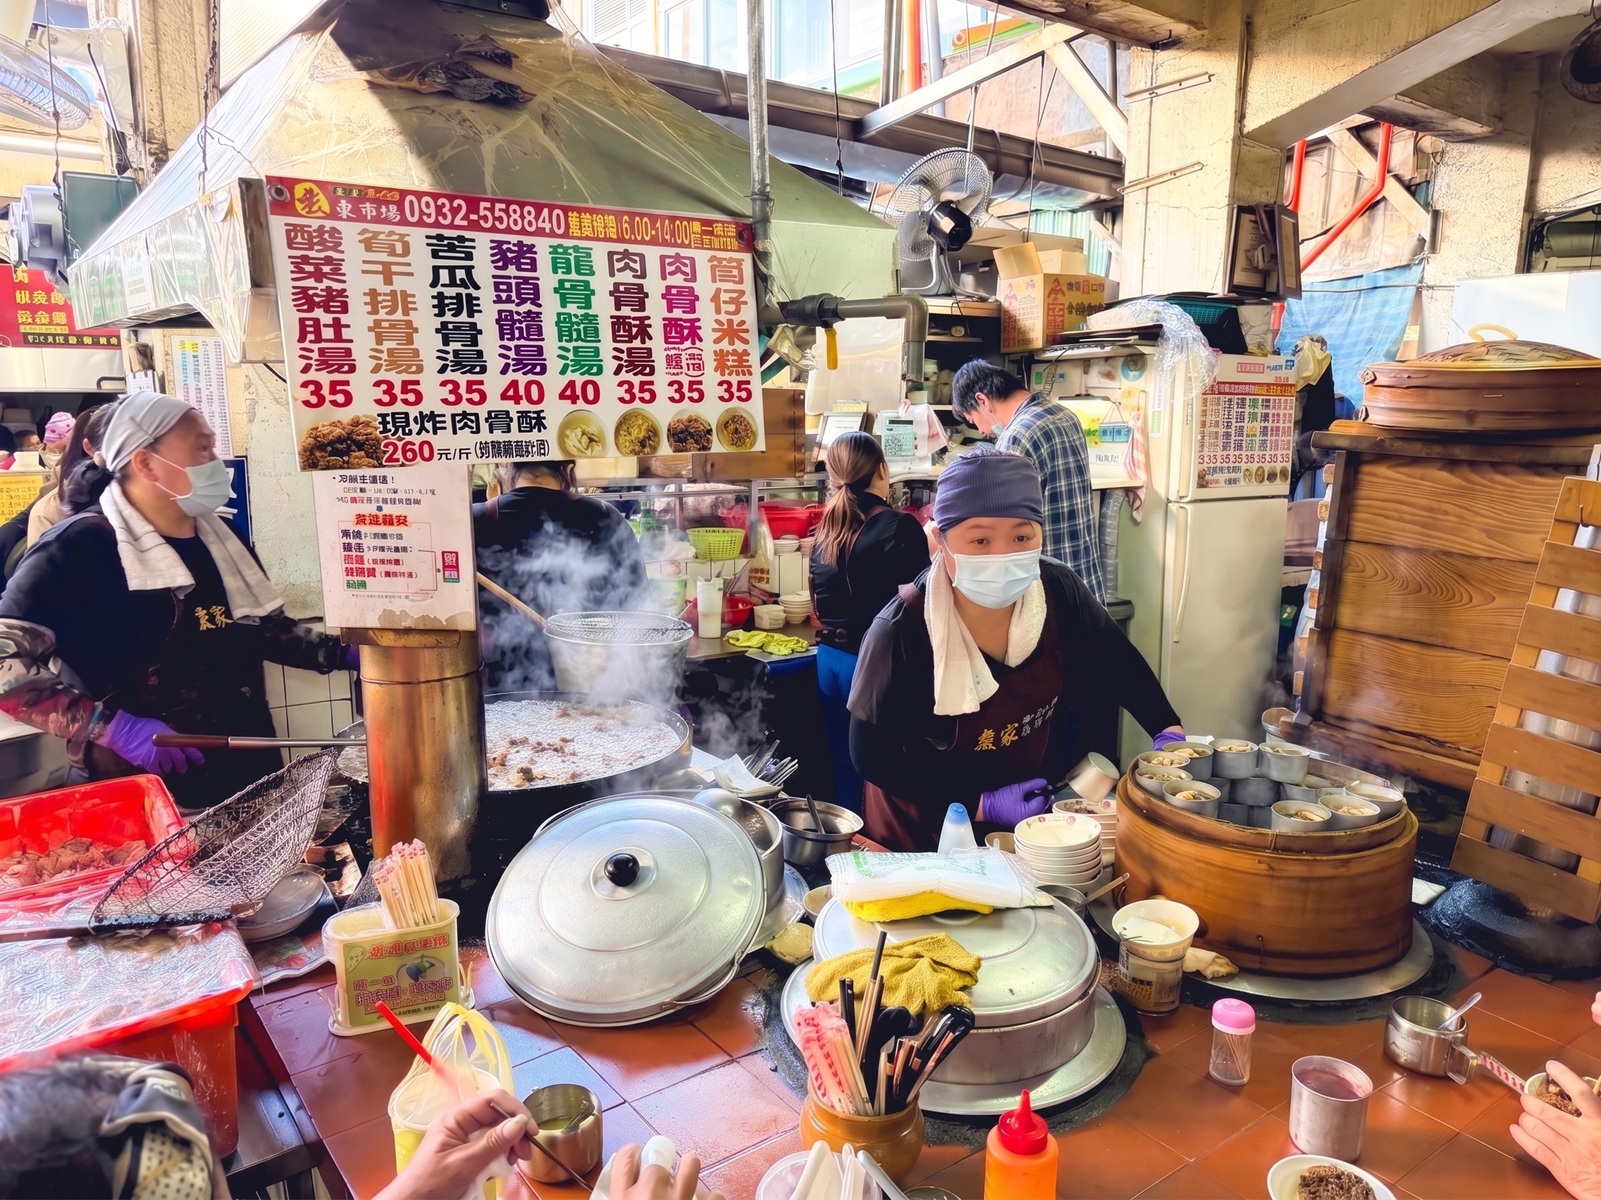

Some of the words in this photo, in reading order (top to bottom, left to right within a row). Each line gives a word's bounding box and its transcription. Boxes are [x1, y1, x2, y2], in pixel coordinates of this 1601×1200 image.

[336, 199, 401, 222] 東市場
[404, 194, 566, 235] 0932-558840
[284, 222, 357, 375] 酸菜豬肚湯
[357, 228, 424, 375] 筍干排骨湯
[425, 233, 488, 375] 苦瓜排骨湯
[489, 239, 548, 377] 豬頭髓湯
[549, 244, 604, 377] 龍骨髓湯
[607, 248, 656, 377] 肉骨酥湯
[707, 255, 753, 377] 筒仔米糕
[301, 379, 354, 409] 35
[372, 379, 424, 407] 35
[439, 379, 487, 406] 35
[500, 379, 546, 405] 40
[558, 379, 601, 405] 40
[617, 379, 657, 404] 35
[667, 379, 705, 404] 35
[717, 379, 753, 403] 35
[377, 409, 548, 437] 現炸肉骨酥
[382, 440, 435, 464] 260
